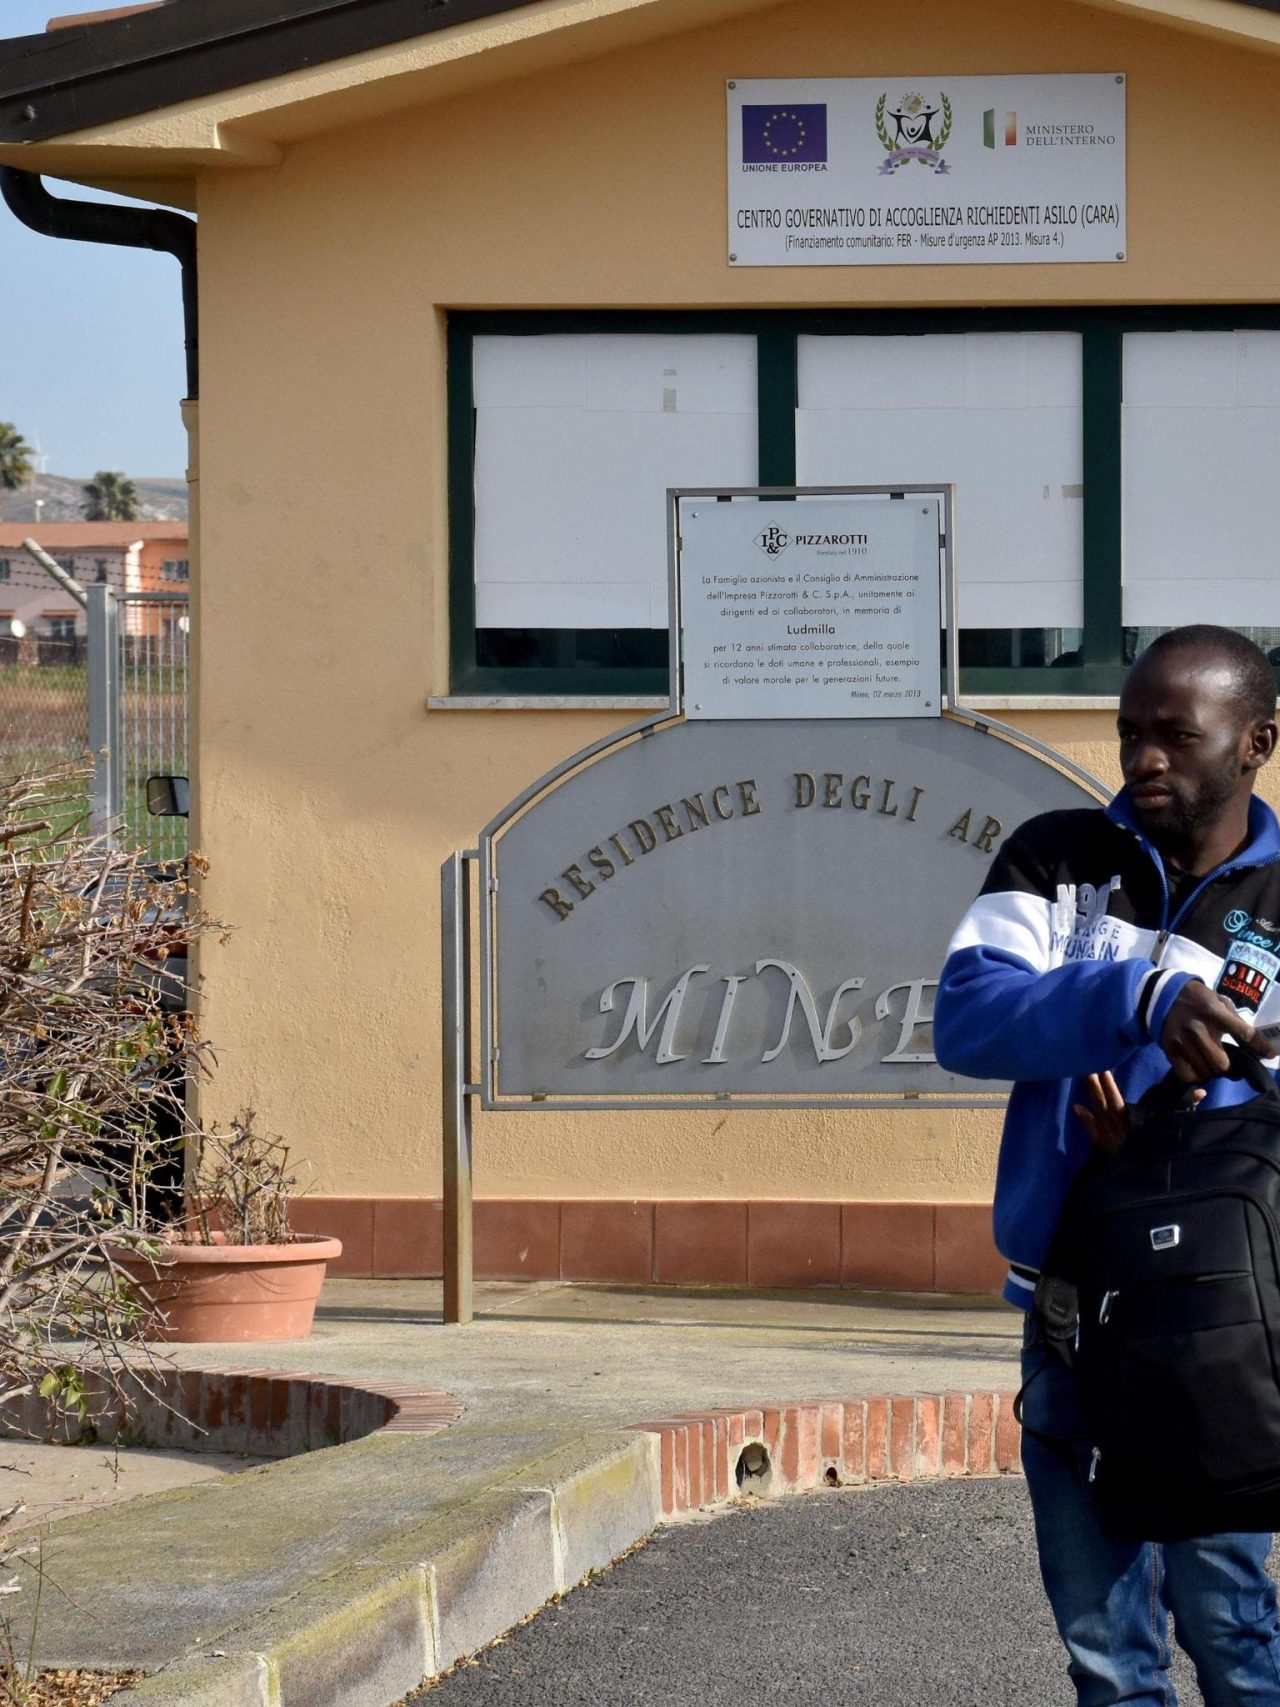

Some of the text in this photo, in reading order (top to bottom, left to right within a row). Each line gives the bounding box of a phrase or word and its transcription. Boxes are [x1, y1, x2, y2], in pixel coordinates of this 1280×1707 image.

[1026, 124, 1094, 135] MINISTERO
[1026, 135, 1117, 146] DELL'INTERNO
[742, 163, 828, 172] UNIONE EUROPEA
[737, 203, 1120, 229] CENTRO GOVERNATIVO DI ACCOGLIENZA RICHIEDENTI ASILO (CARA)
[785, 234, 844, 251] (Finanziamento
[846, 234, 894, 248] comunitario:
[897, 233, 912, 247] FER
[920, 233, 945, 247] Misure
[948, 232, 986, 249] d'urgenza
[988, 232, 998, 246] AP
[1025, 232, 1051, 246] Misura
[795, 534, 868, 545] PIZZAROTTI
[702, 575, 711, 584] La
[713, 575, 748, 586] Famiglia
[750, 575, 786, 583] azionista
[803, 573, 841, 584] Consiglio
[843, 573, 851, 582] di
[854, 573, 919, 582] Amministrazione
[706, 591, 757, 602] dell'Impresa
[760, 591, 799, 600] Pizzarotti
[802, 590, 809, 599] &
[858, 590, 903, 599] unitamente
[906, 590, 915, 598] ai
[720, 605, 902, 619] dirigenti ed ai collaboratori, in memoria di
[787, 624, 836, 635] Ludmilla
[713, 641, 910, 654] per 12 anni stimata collaboratrice, della quale
[703, 661, 711, 669] si
[713, 660, 754, 669] ricordano
[757, 659, 765, 668] le
[768, 659, 784, 668] doti
[787, 660, 815, 668] umane
[827, 657, 882, 669] professionali,
[885, 659, 920, 669] esempio
[722, 676, 731, 685] di
[734, 675, 760, 684] valore
[763, 675, 792, 684] morale
[795, 676, 809, 686] per
[812, 674, 820, 683] le
[823, 674, 872, 685] generazioni
[872, 690, 882, 698] 02
[904, 689, 921, 698] 2013
[538, 772, 1002, 921] RESIDENCE DEGLI AR
[584, 958, 940, 1064] MINE
